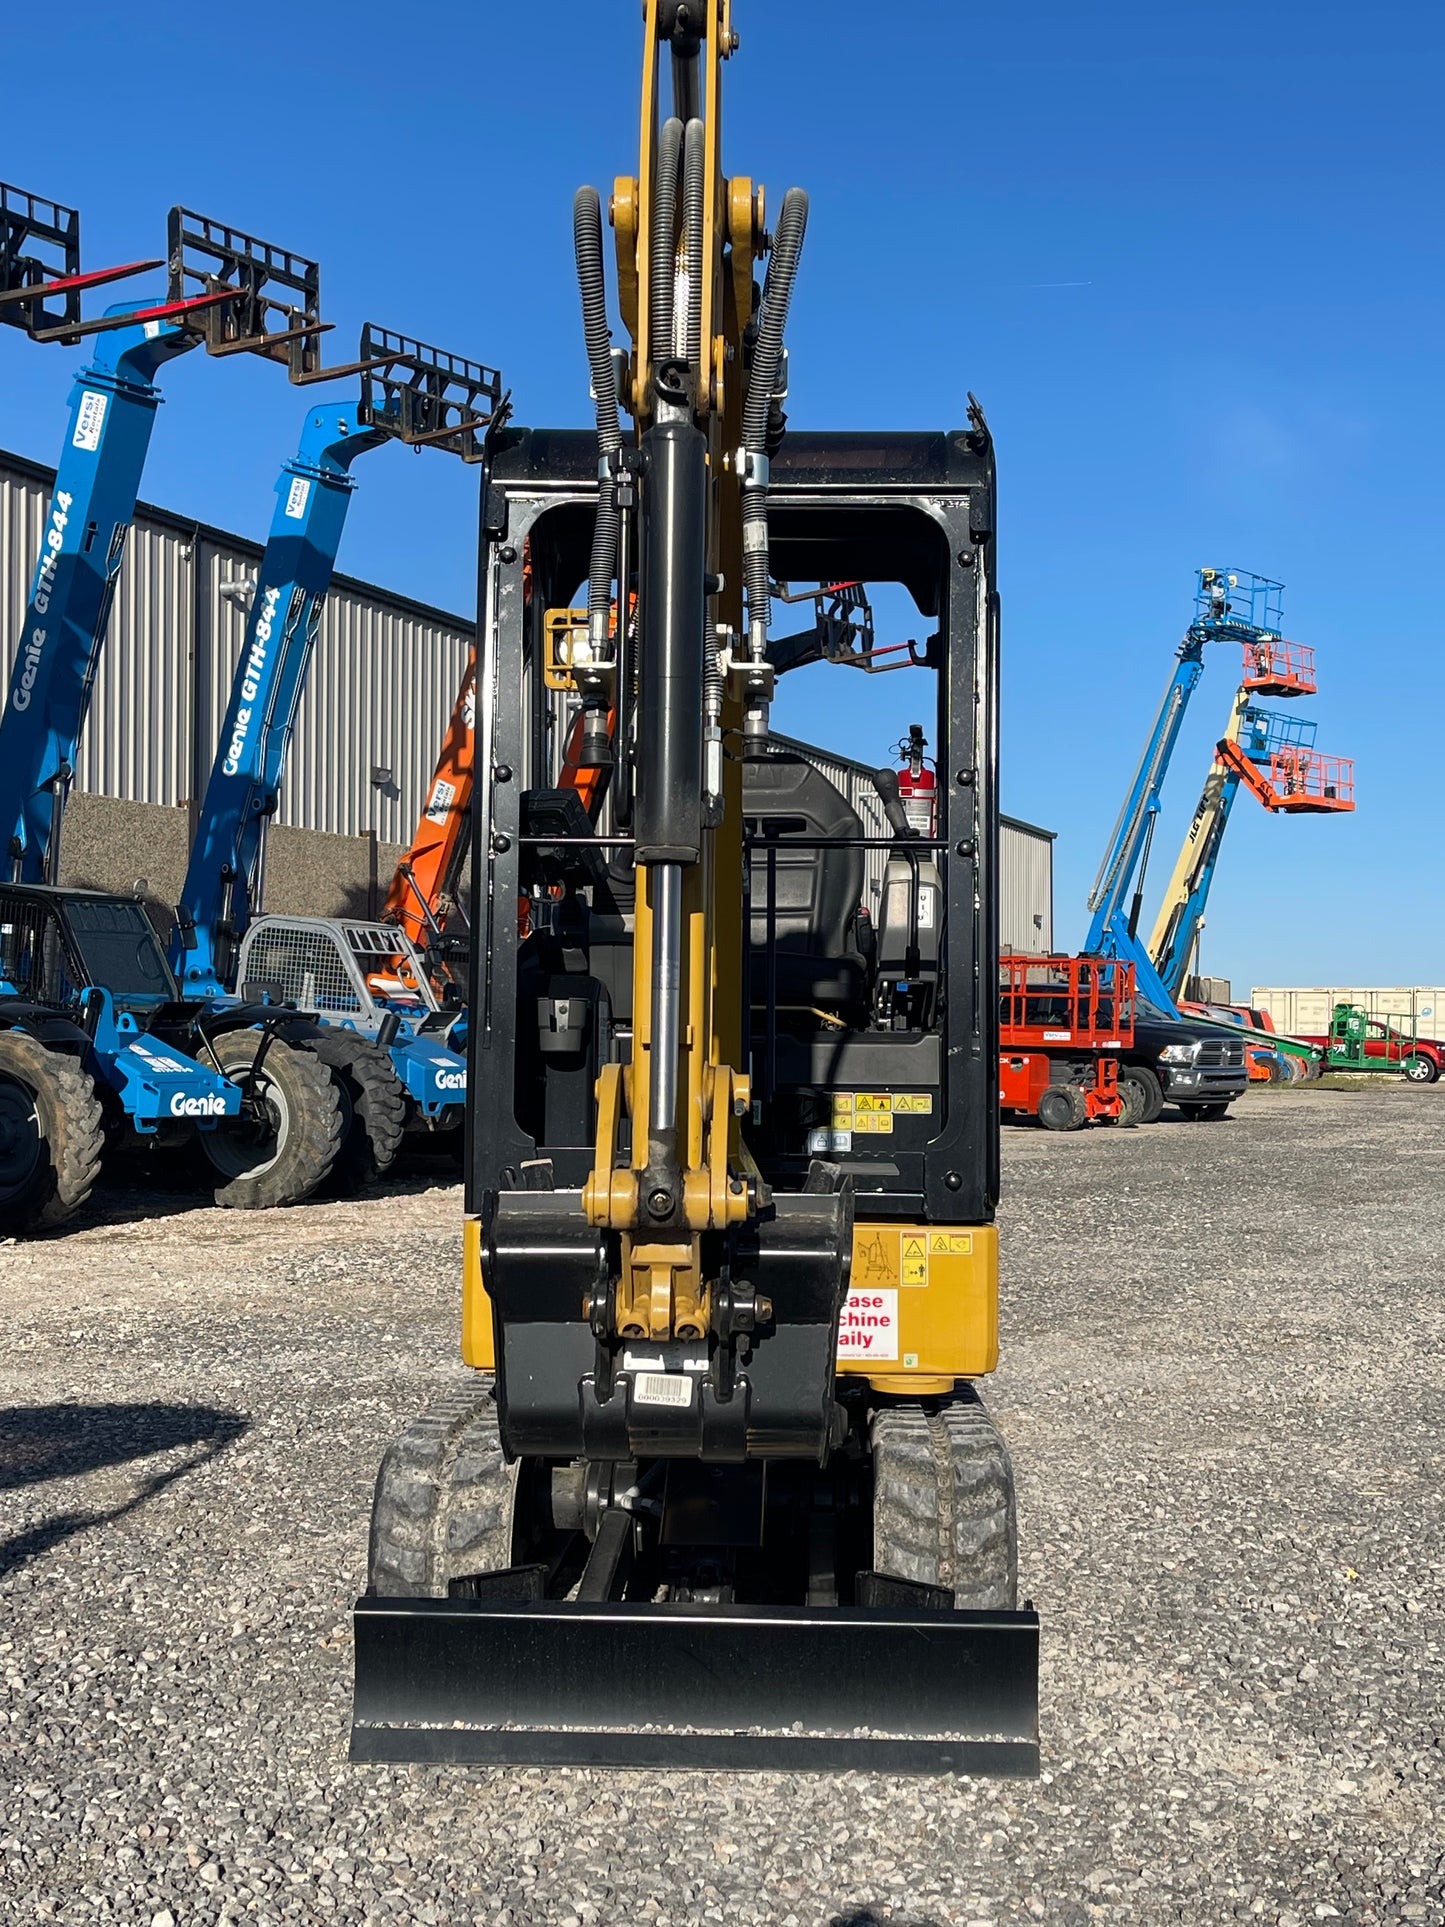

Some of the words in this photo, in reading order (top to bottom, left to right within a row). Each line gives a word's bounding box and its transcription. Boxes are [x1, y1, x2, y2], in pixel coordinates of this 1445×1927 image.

[76, 395, 94, 442] Versi
[12, 627, 47, 712] Genie
[34, 489, 73, 614] GTH-844
[222, 708, 252, 777] Genie
[241, 585, 281, 702] GTH-844
[427, 781, 446, 817] Versi
[1189, 821, 1201, 844] JLG
[1196, 794, 1210, 821] LIFT
[170, 1092, 226, 1116] Genie
[843, 1296, 883, 1308] ase
